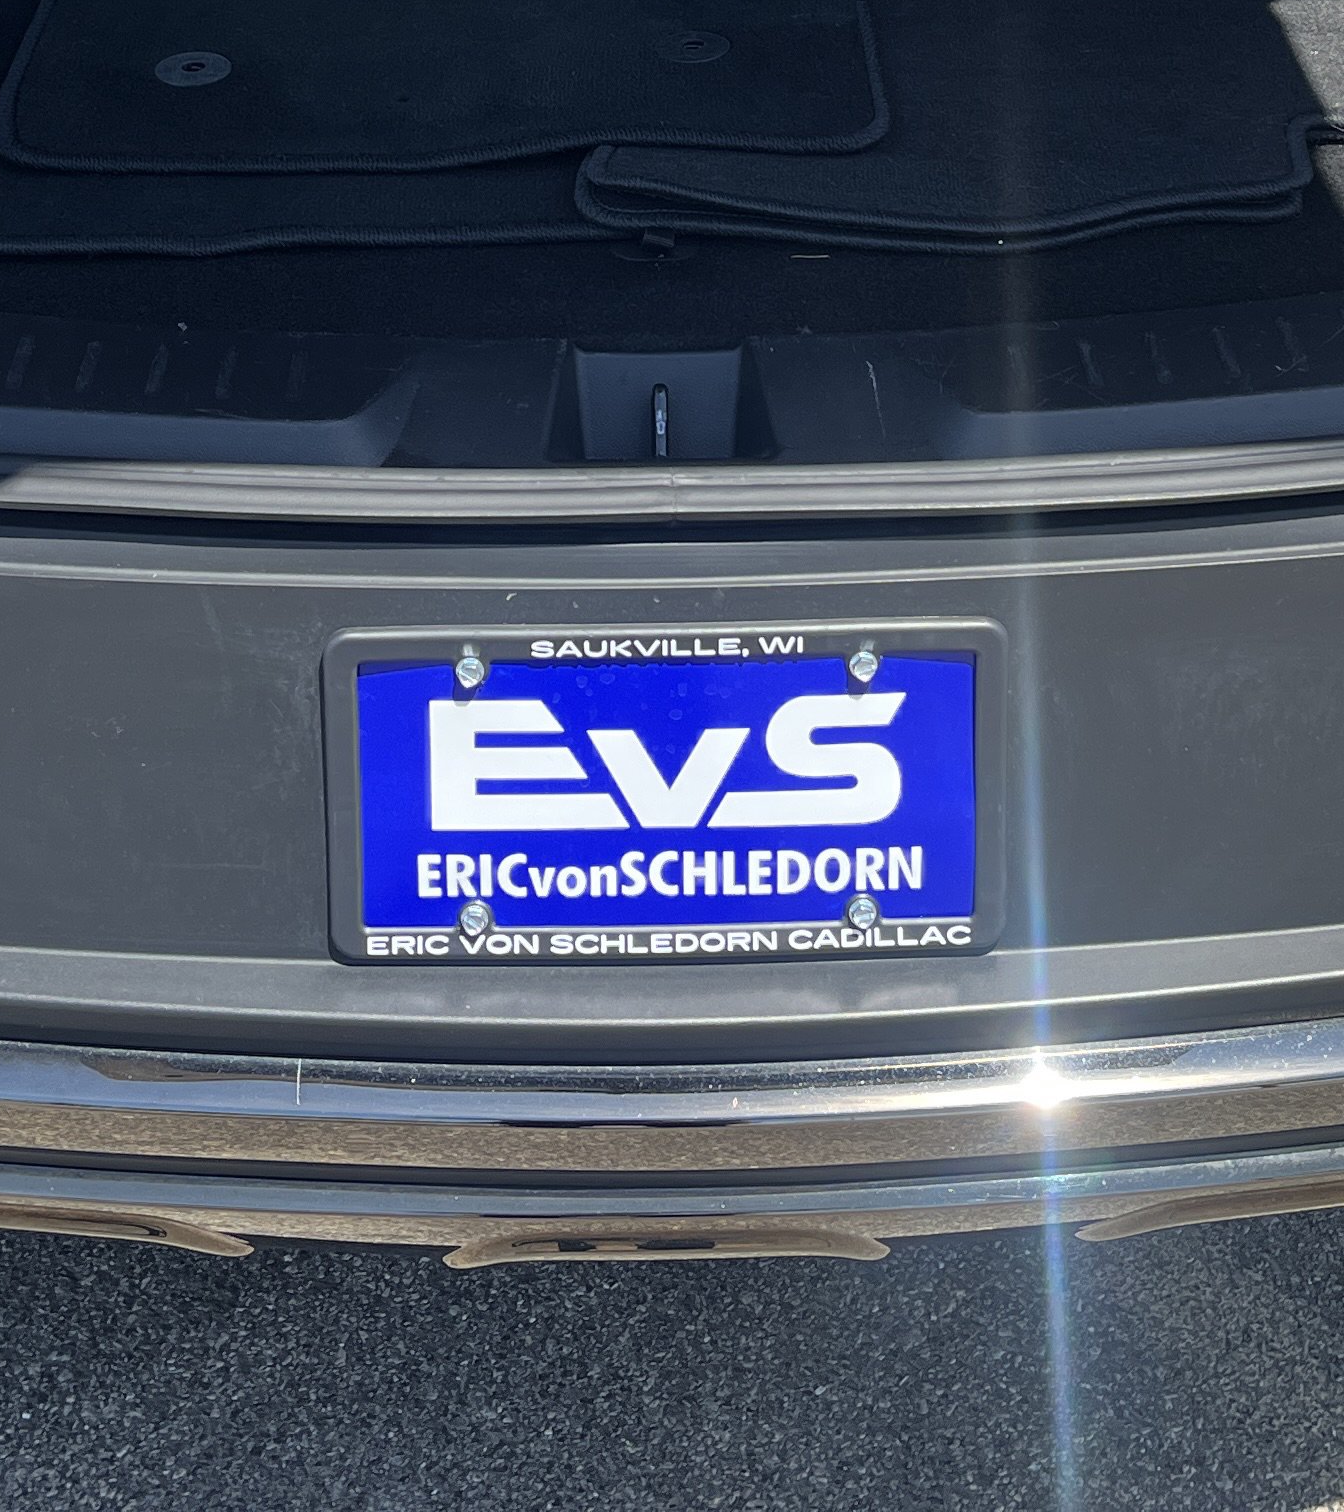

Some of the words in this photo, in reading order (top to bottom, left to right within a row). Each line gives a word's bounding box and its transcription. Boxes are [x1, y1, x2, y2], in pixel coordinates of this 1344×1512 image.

[530, 637, 750, 658] SAUKVILLE,
[758, 636, 804, 655] WI
[416, 845, 924, 899] ERICvonSCHLEDORN
[366, 935, 450, 956] ERIC
[459, 934, 540, 955] VON
[550, 931, 778, 955] SCHLEDORN
[788, 925, 972, 950] CADILLAC
